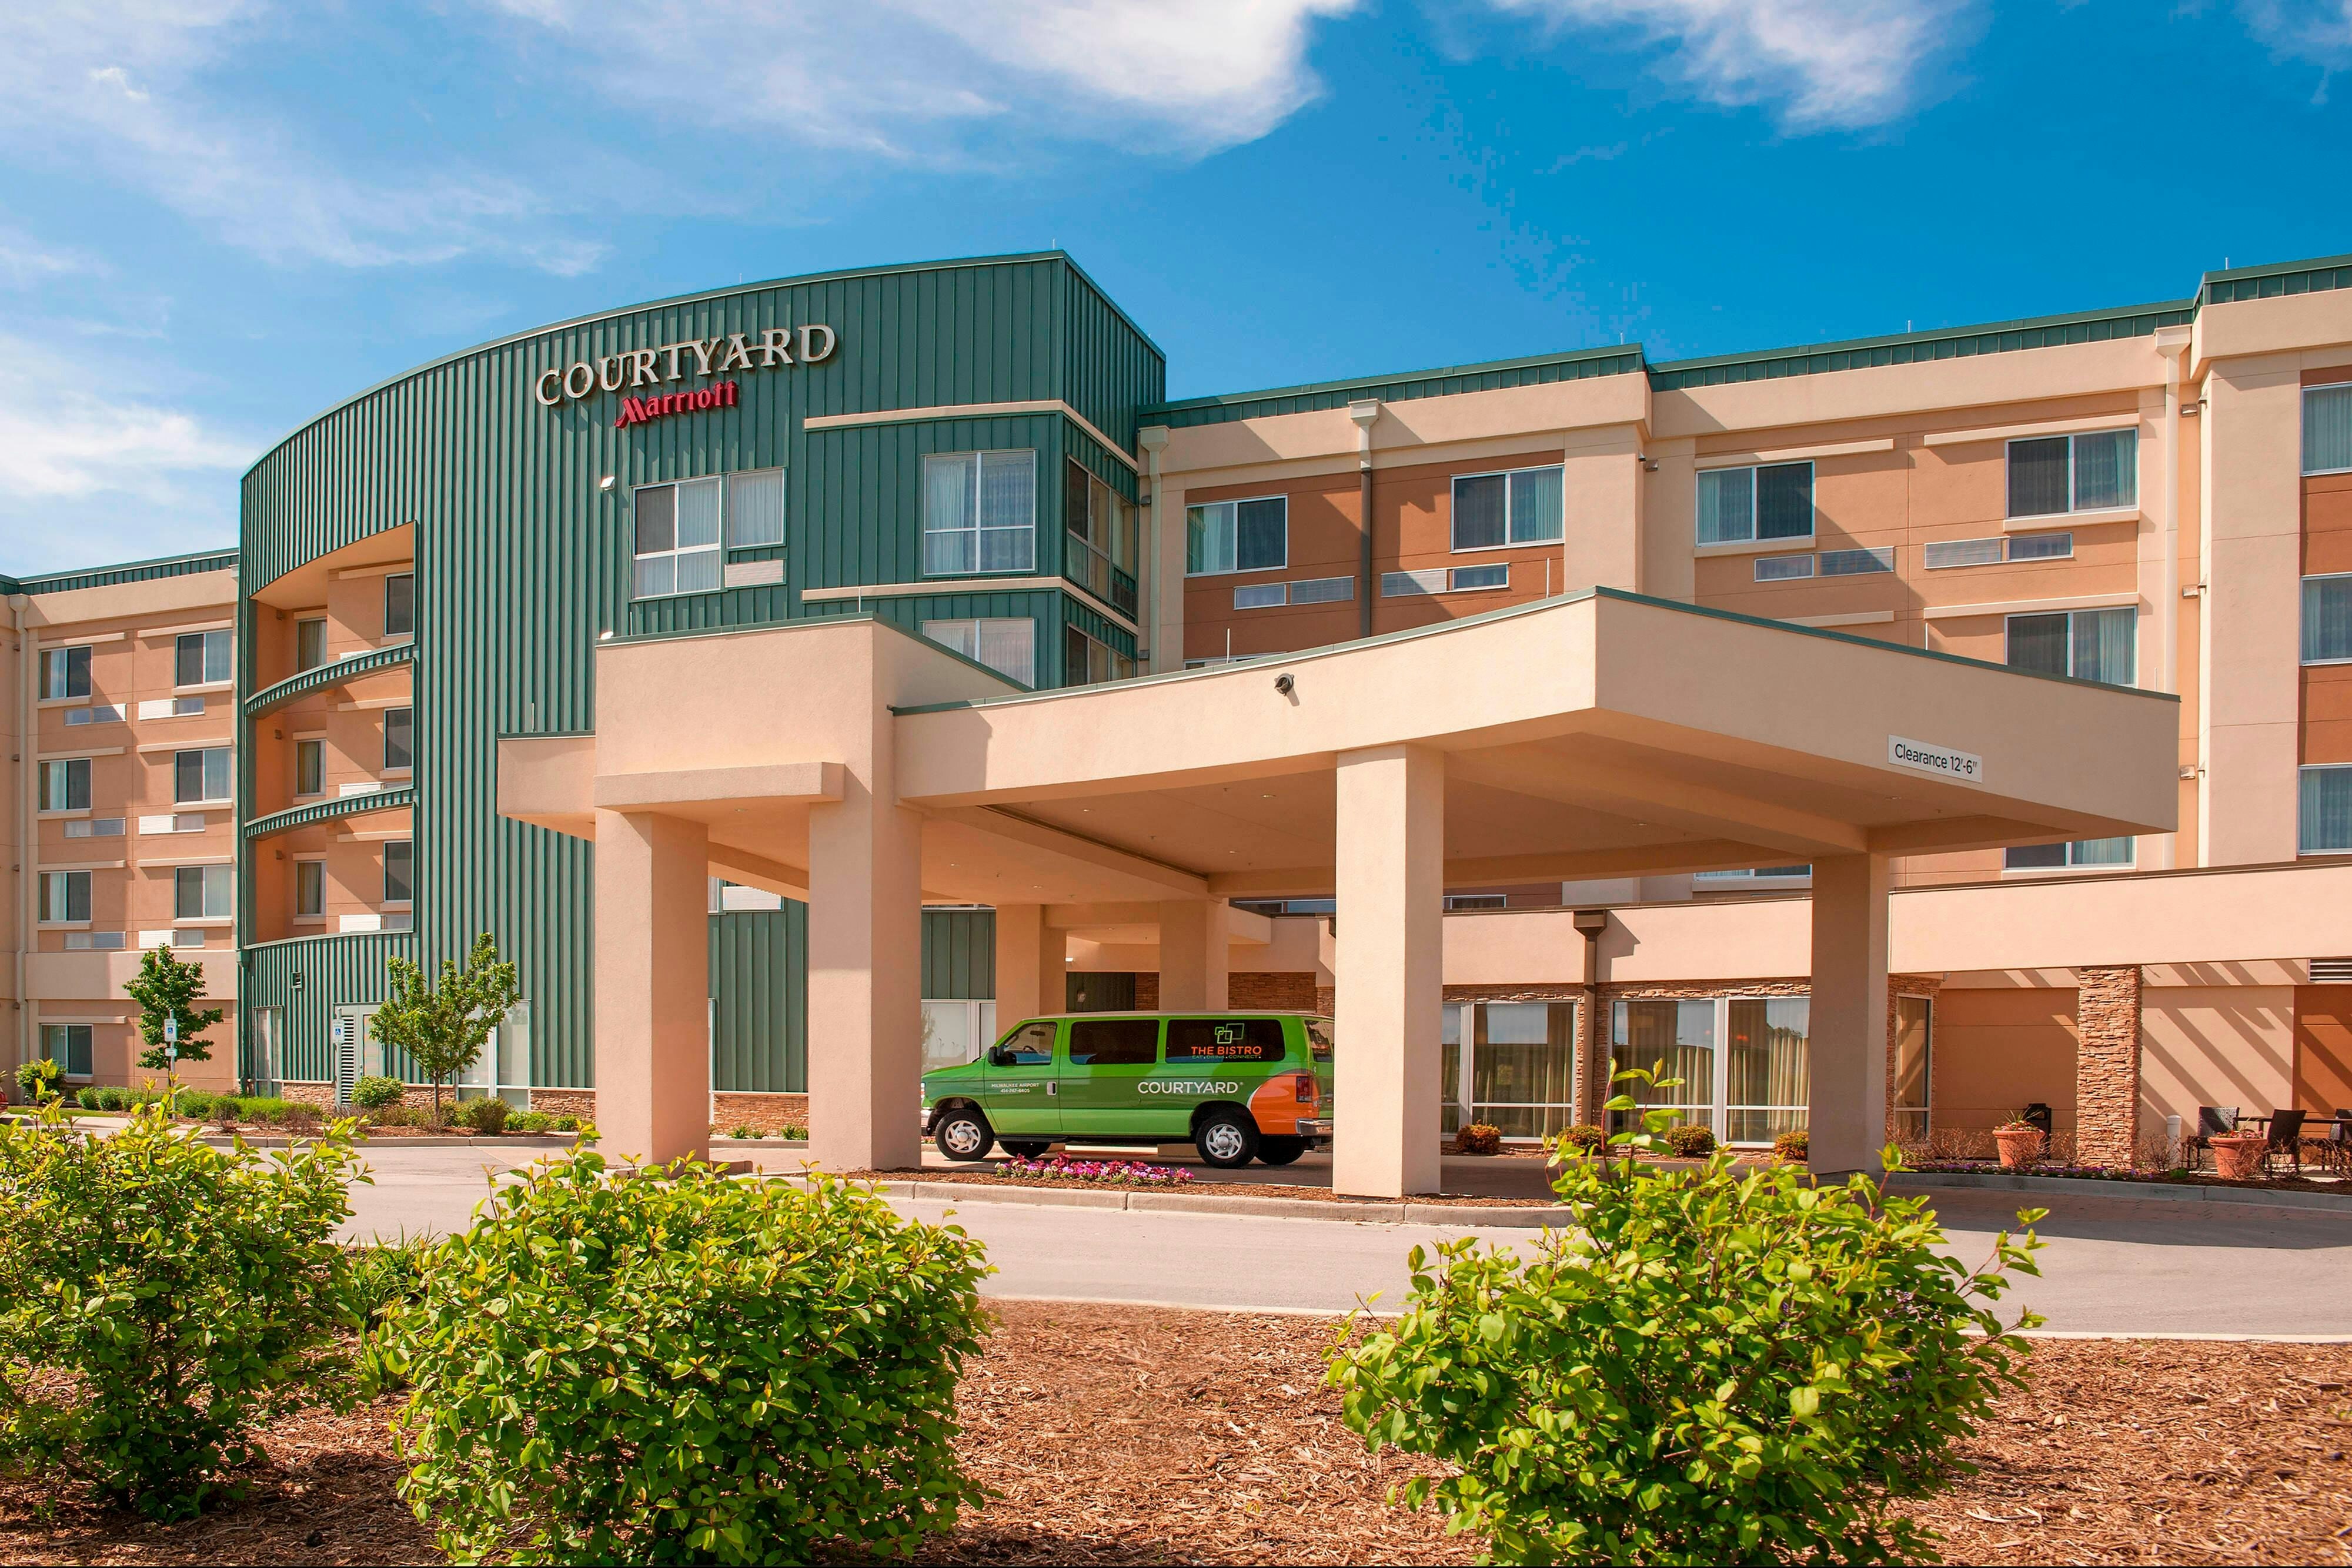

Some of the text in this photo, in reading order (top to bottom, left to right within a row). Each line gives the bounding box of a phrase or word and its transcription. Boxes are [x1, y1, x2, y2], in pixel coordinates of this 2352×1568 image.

[536, 325, 836, 406] COURTYARD
[614, 379, 739, 429] Marriott
[1895, 743, 1977, 774] Clearance 12'-6"
[1191, 1046, 1262, 1055] THE BISTRO
